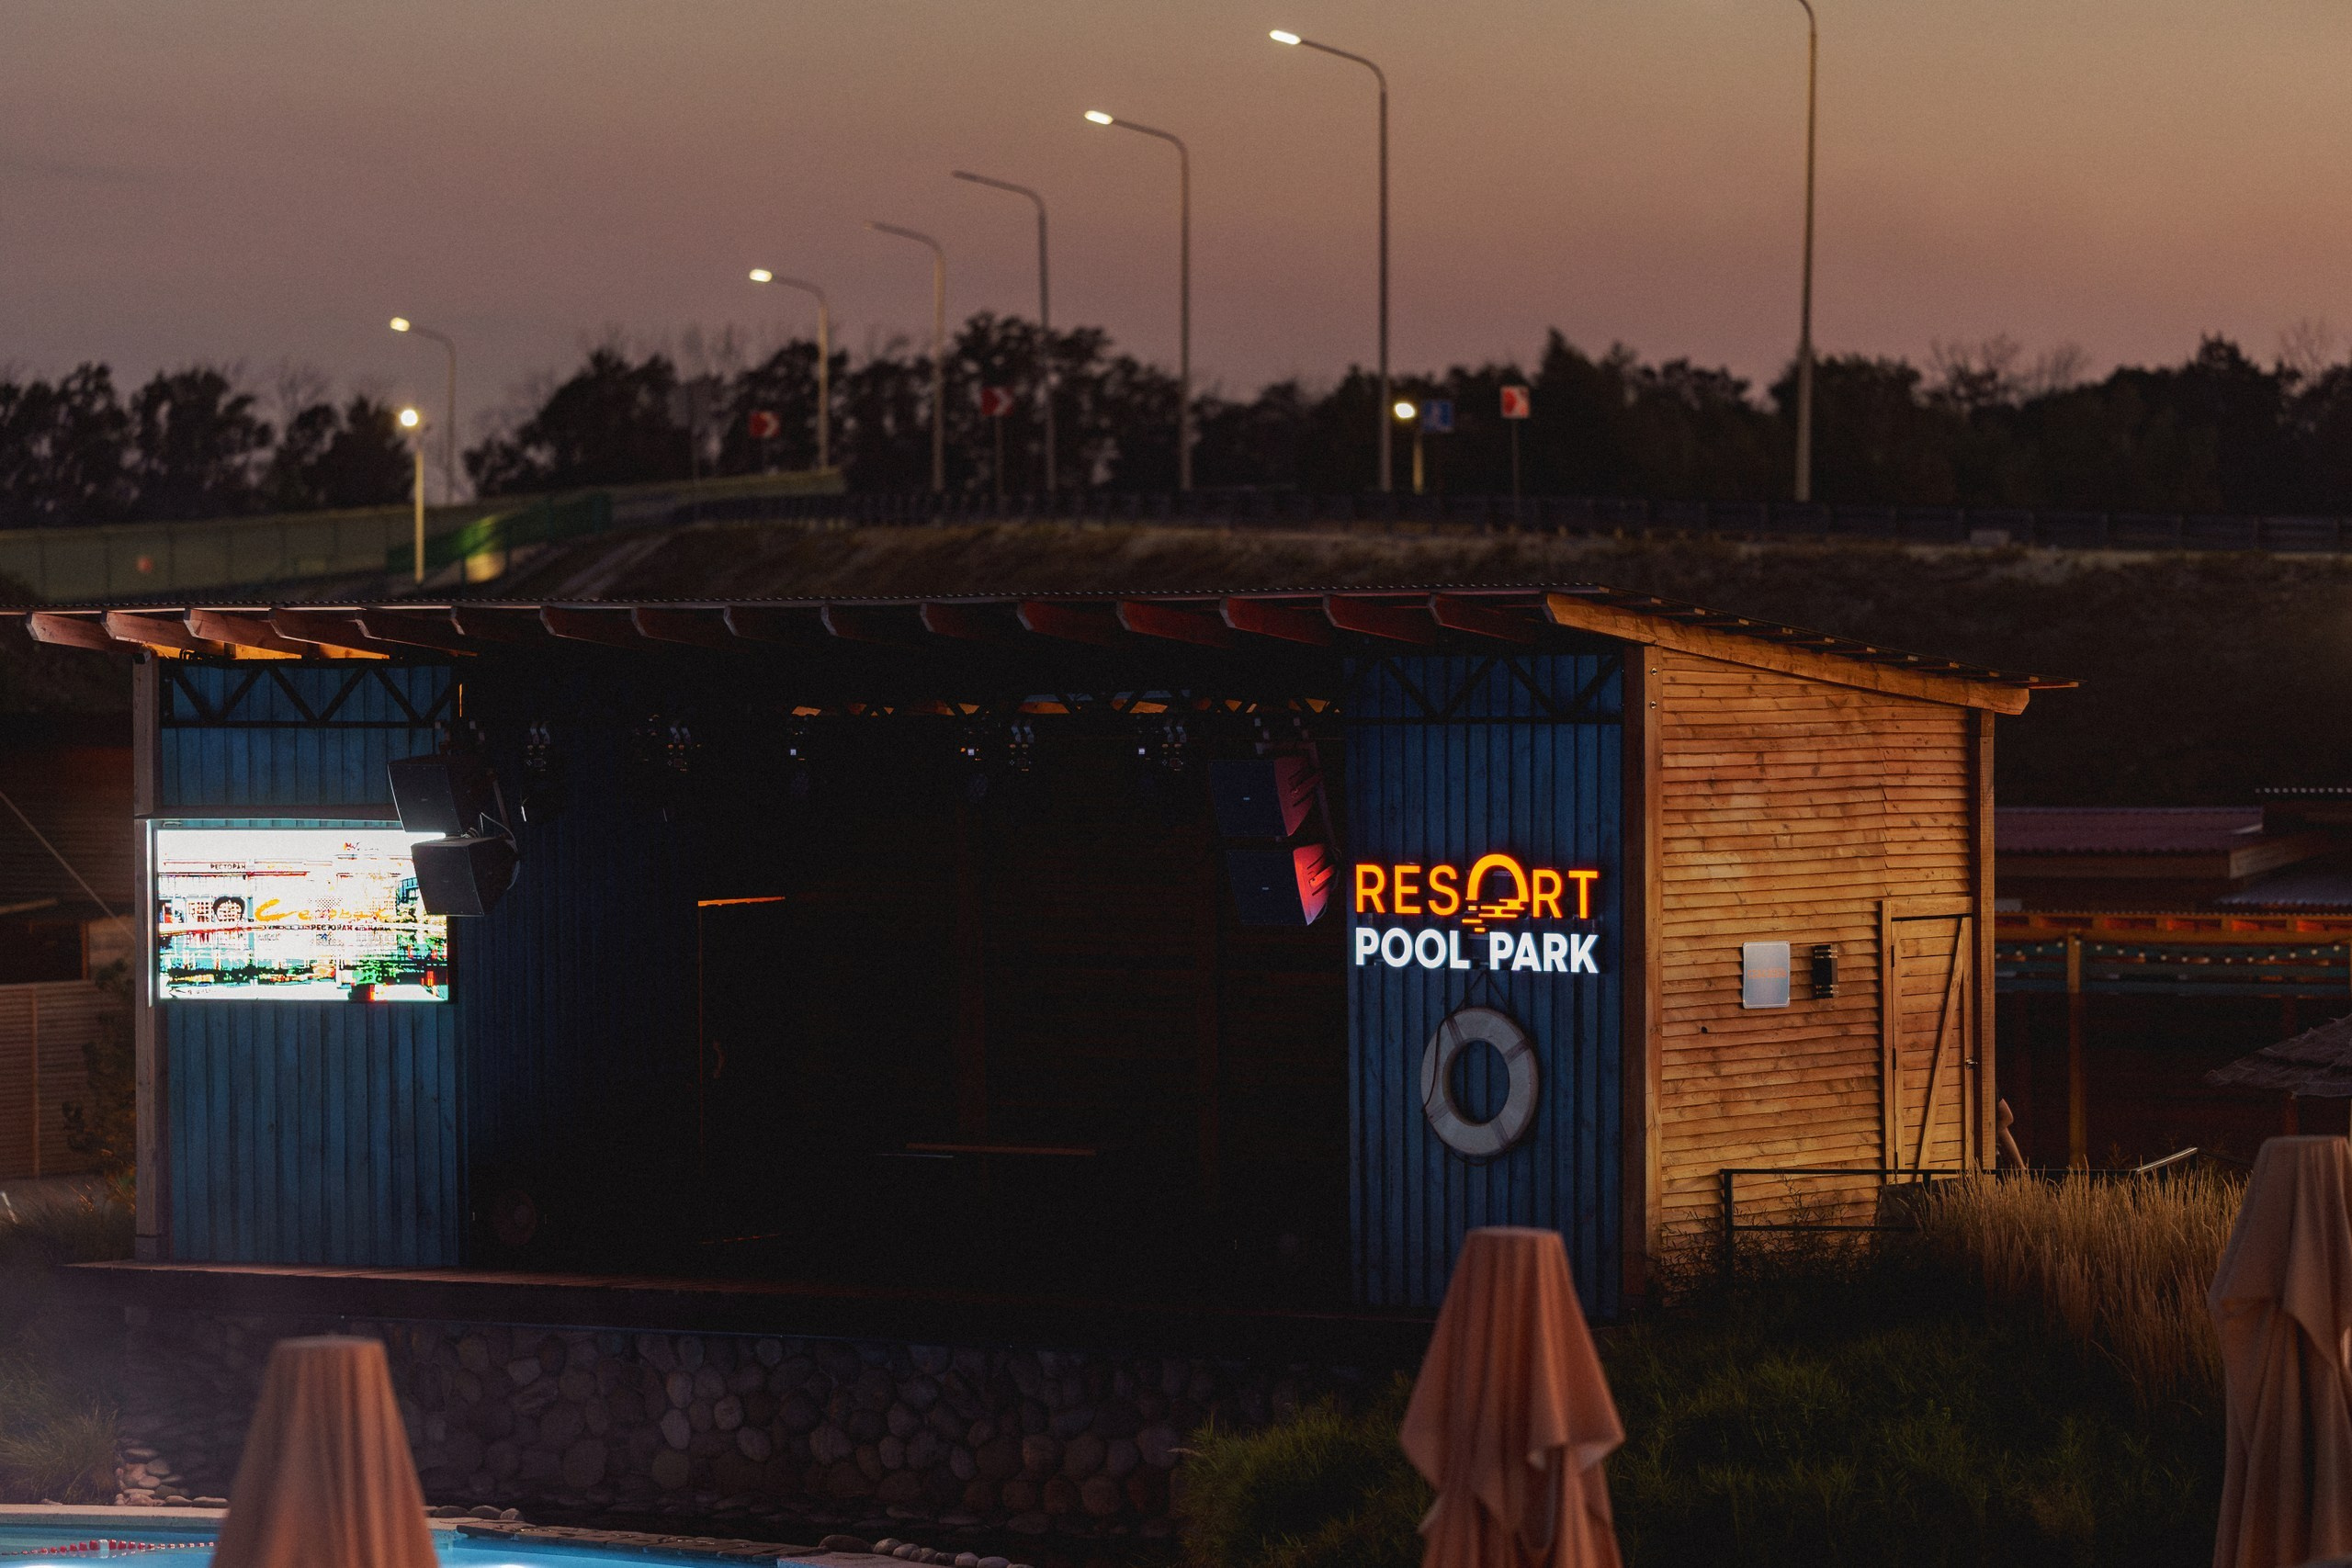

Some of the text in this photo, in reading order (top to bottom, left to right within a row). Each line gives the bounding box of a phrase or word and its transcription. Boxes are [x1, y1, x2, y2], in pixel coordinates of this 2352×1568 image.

[1355, 853, 1599, 919] RESORT
[1355, 927, 1600, 974] POOL PARK
